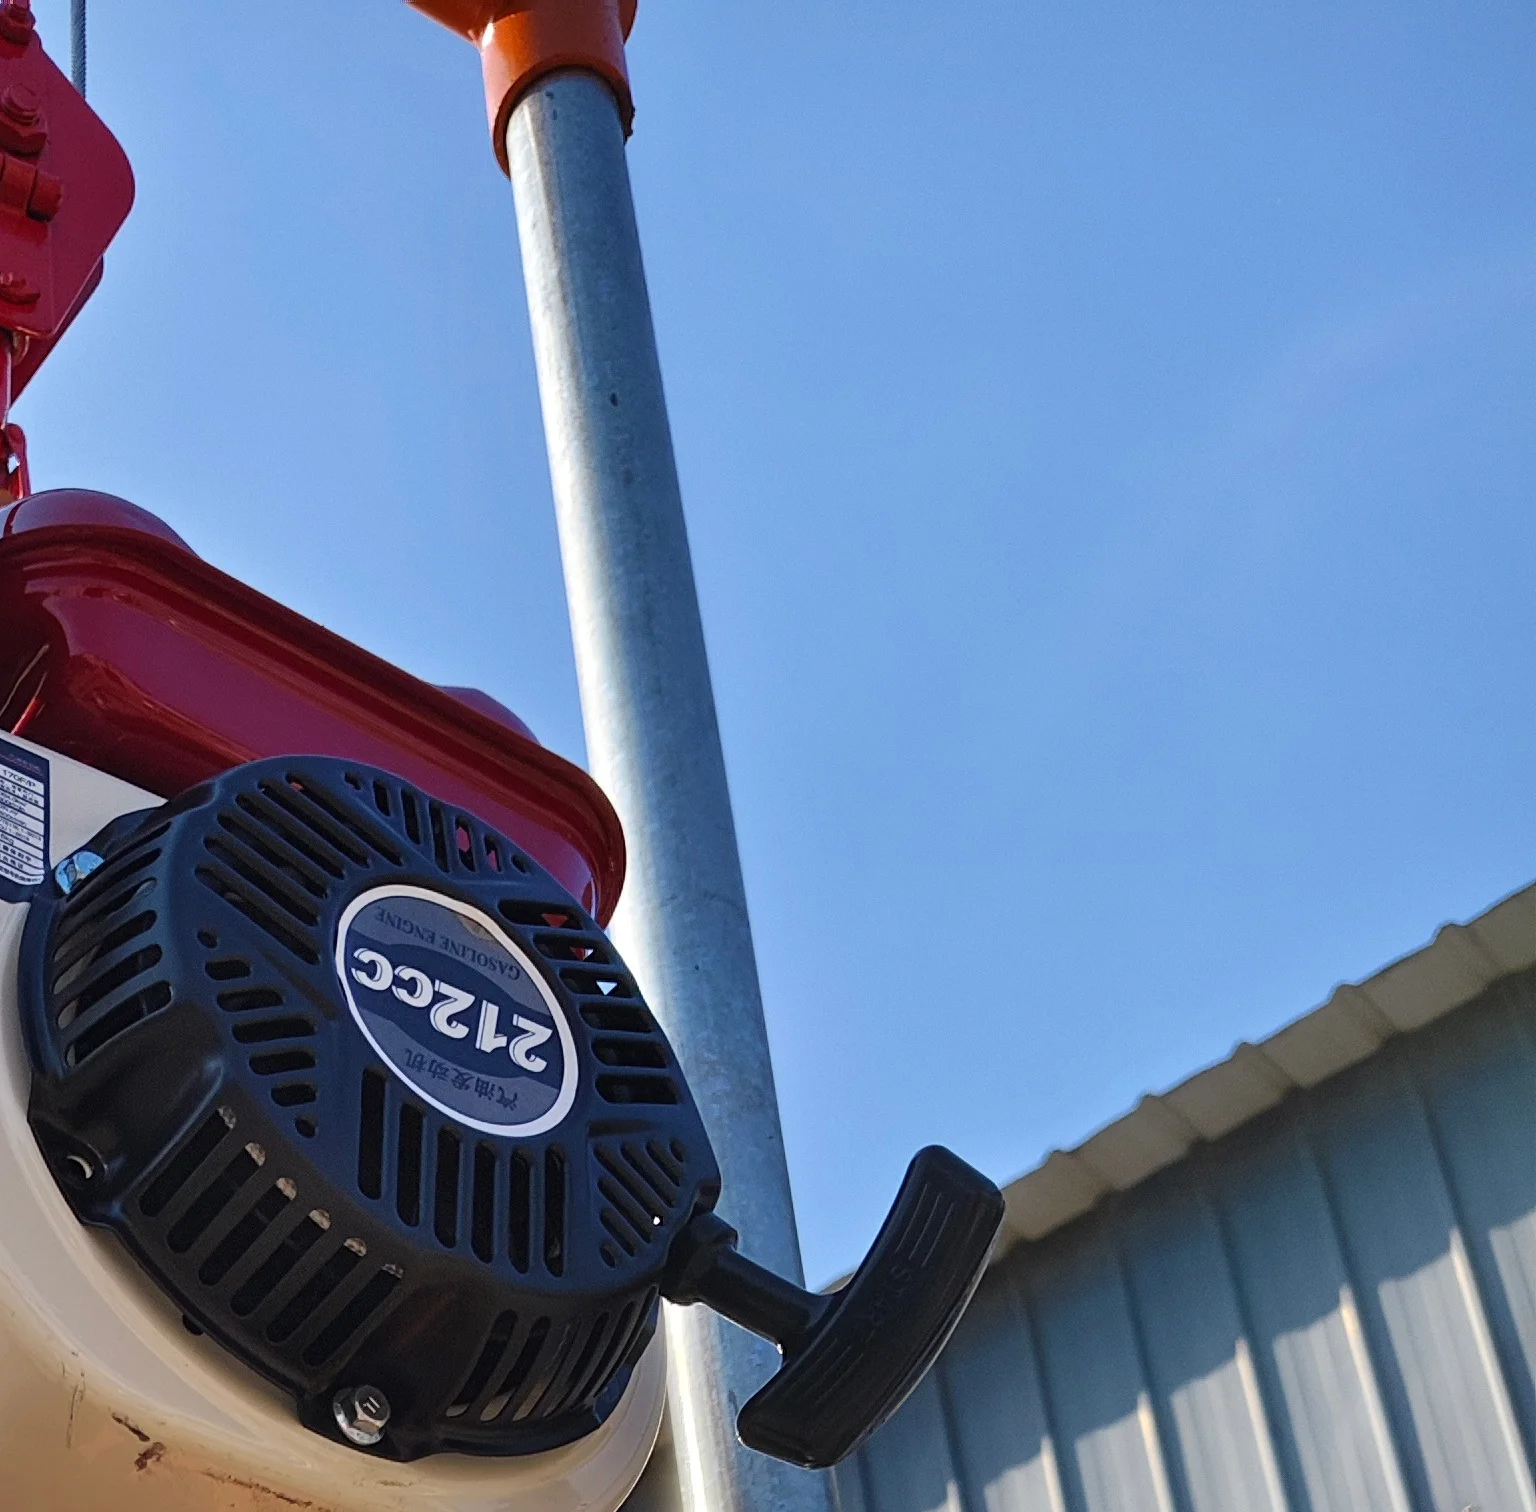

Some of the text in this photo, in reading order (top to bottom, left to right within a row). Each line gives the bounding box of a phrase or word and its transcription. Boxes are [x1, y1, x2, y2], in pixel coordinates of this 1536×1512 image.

[3, 769, 36, 788] 170F/P
[375, 905, 521, 981] GASOLINE ENGINE
[351, 947, 553, 1073] 212cc
[405, 1048, 518, 1111] 汽油发动机
